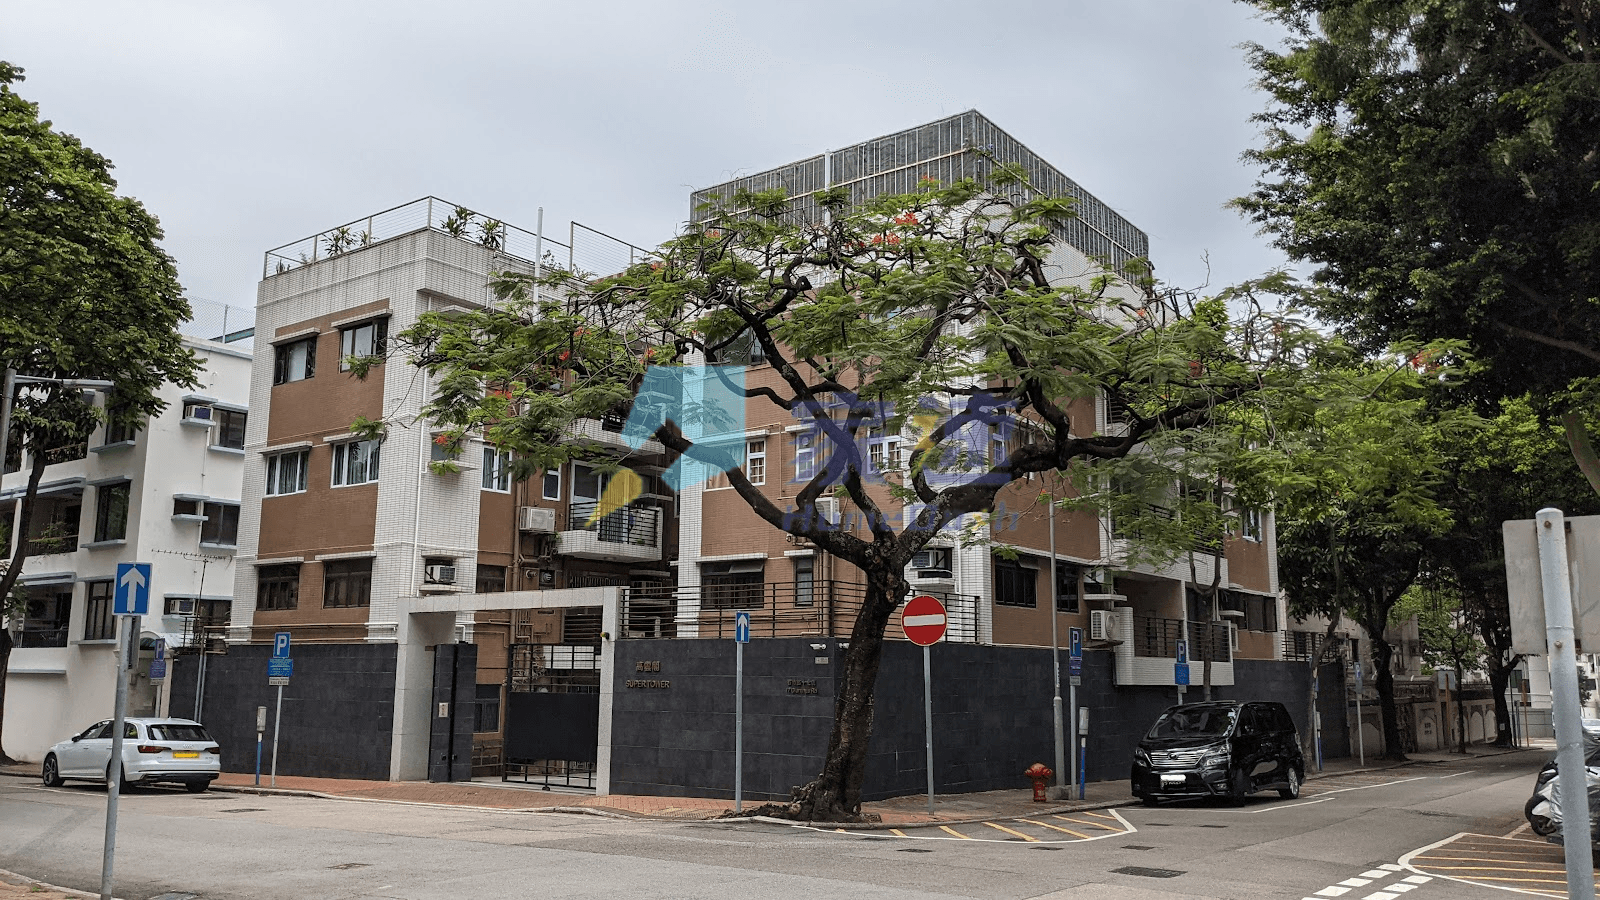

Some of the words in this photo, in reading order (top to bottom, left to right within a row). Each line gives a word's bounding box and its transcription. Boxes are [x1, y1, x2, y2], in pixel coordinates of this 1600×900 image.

[155, 641, 163, 658] P
[276, 635, 288, 656] P
[1072, 631, 1080, 654] P
[1178, 642, 1185, 662] P
